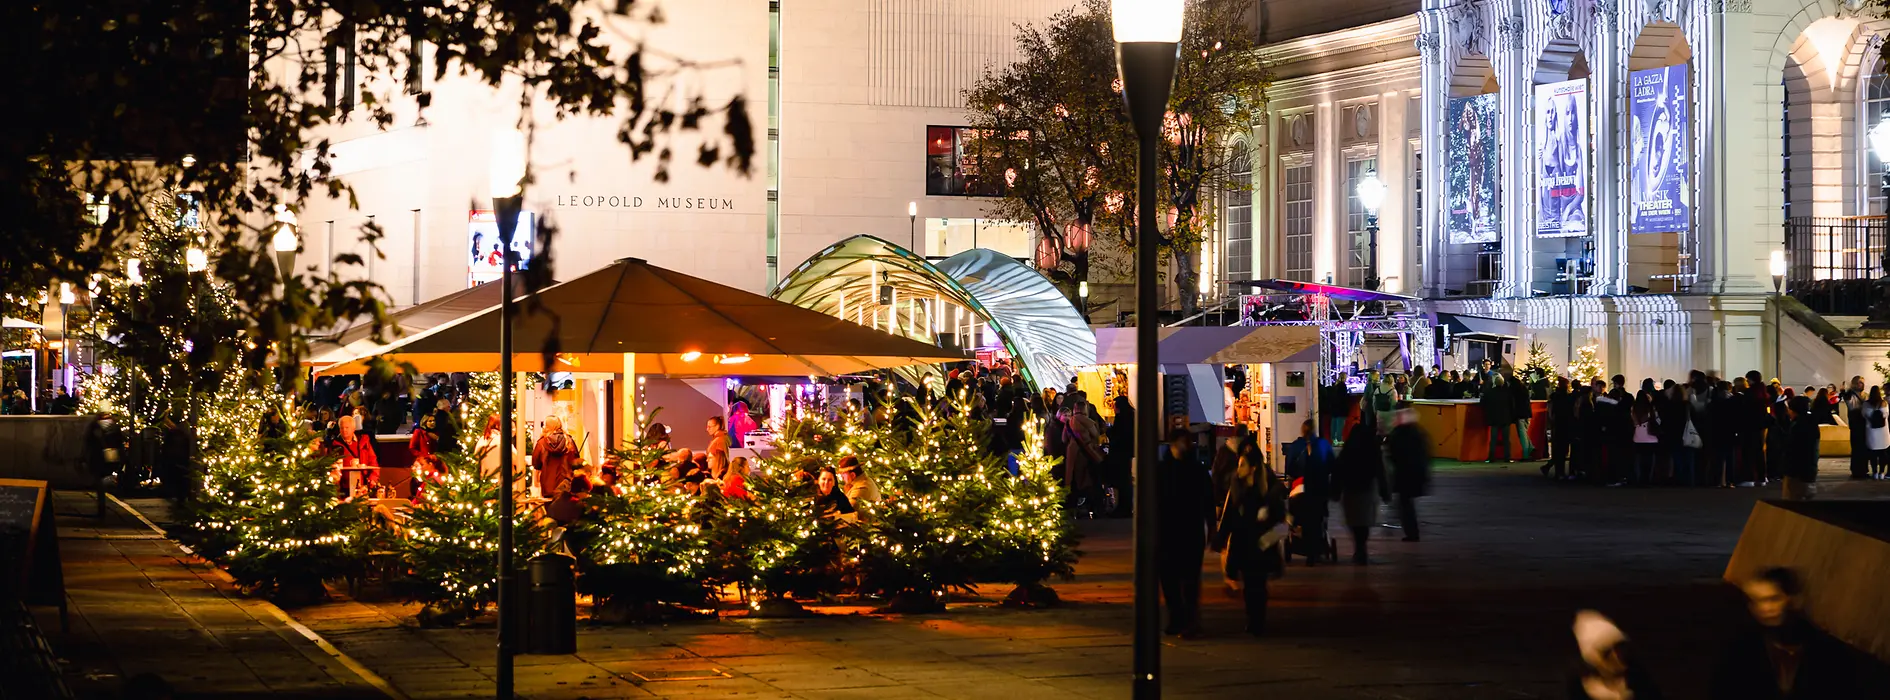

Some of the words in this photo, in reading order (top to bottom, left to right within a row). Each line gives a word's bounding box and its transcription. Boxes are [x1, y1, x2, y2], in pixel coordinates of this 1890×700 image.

[1634, 76, 1643, 86] LA
[1644, 74, 1663, 85] GAZZA
[1634, 86, 1655, 97] LADRA
[557, 195, 643, 208] LEOPOLD
[658, 197, 734, 210] MUSEUM
[1640, 200, 1672, 210] THEATER
